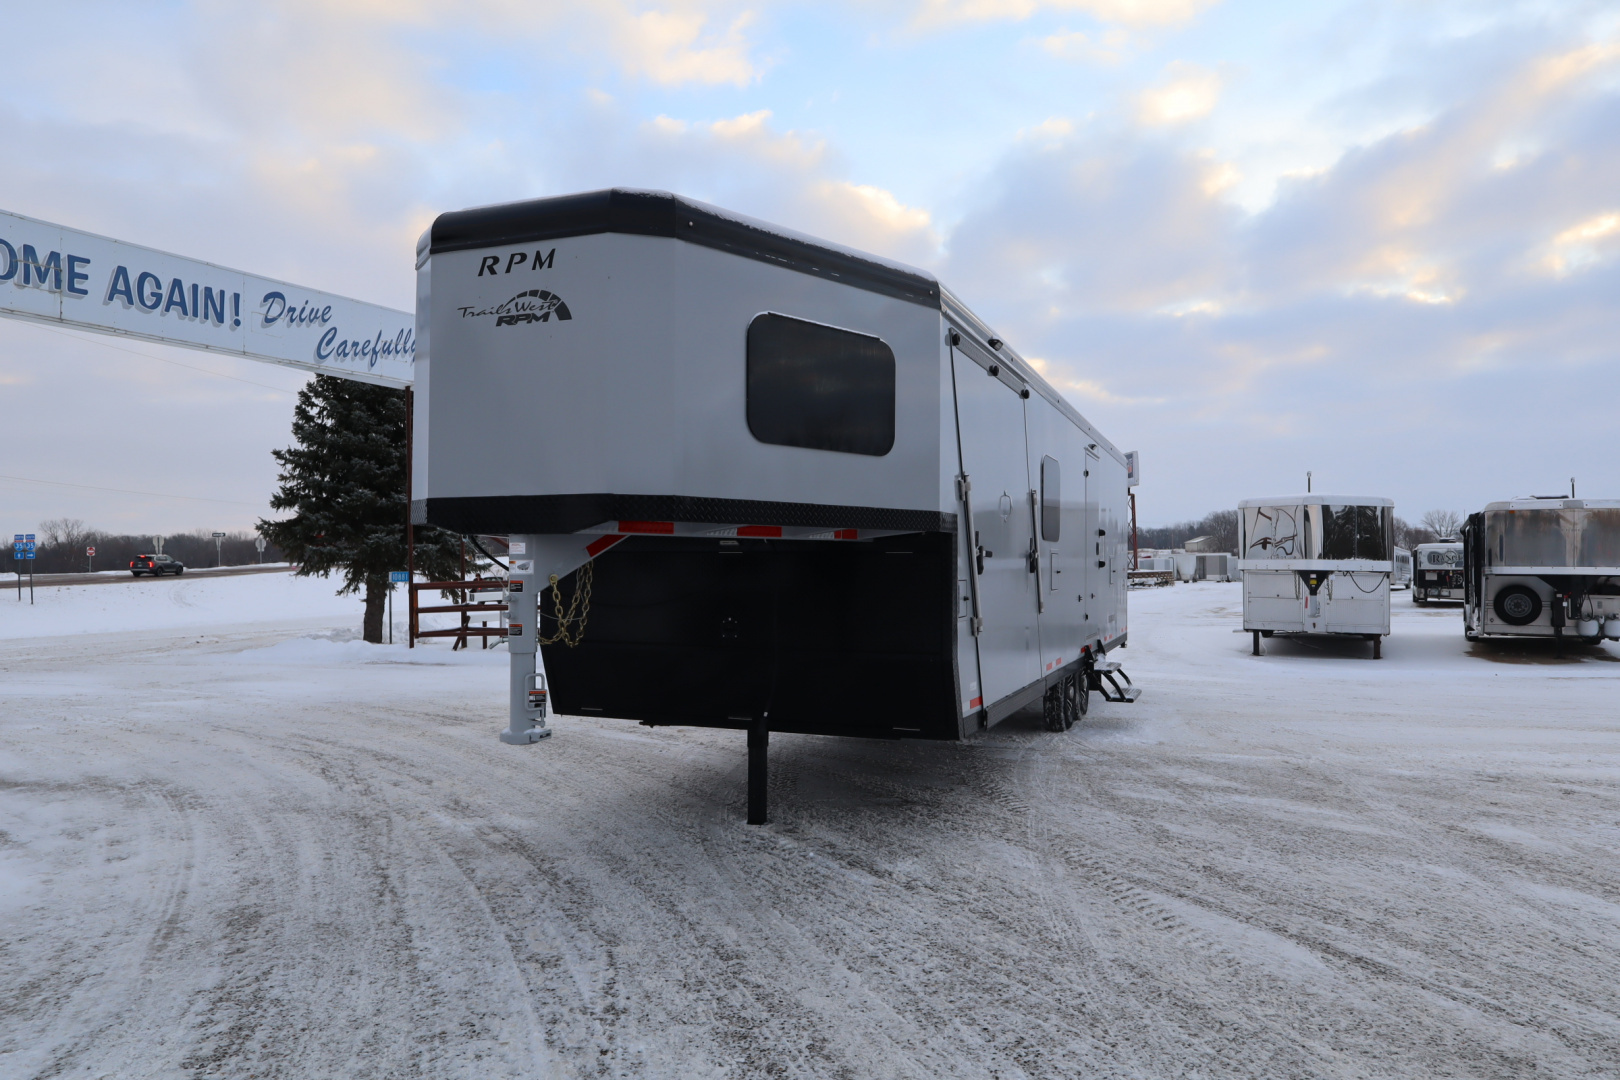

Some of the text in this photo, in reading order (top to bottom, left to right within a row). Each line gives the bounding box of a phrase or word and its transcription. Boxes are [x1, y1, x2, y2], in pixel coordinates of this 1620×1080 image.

[477, 248, 556, 277] RPM
[107, 265, 241, 327] AGAIN!
[262, 291, 332, 324] Drive
[457, 300, 555, 318] Trails West
[495, 311, 551, 327] RPM
